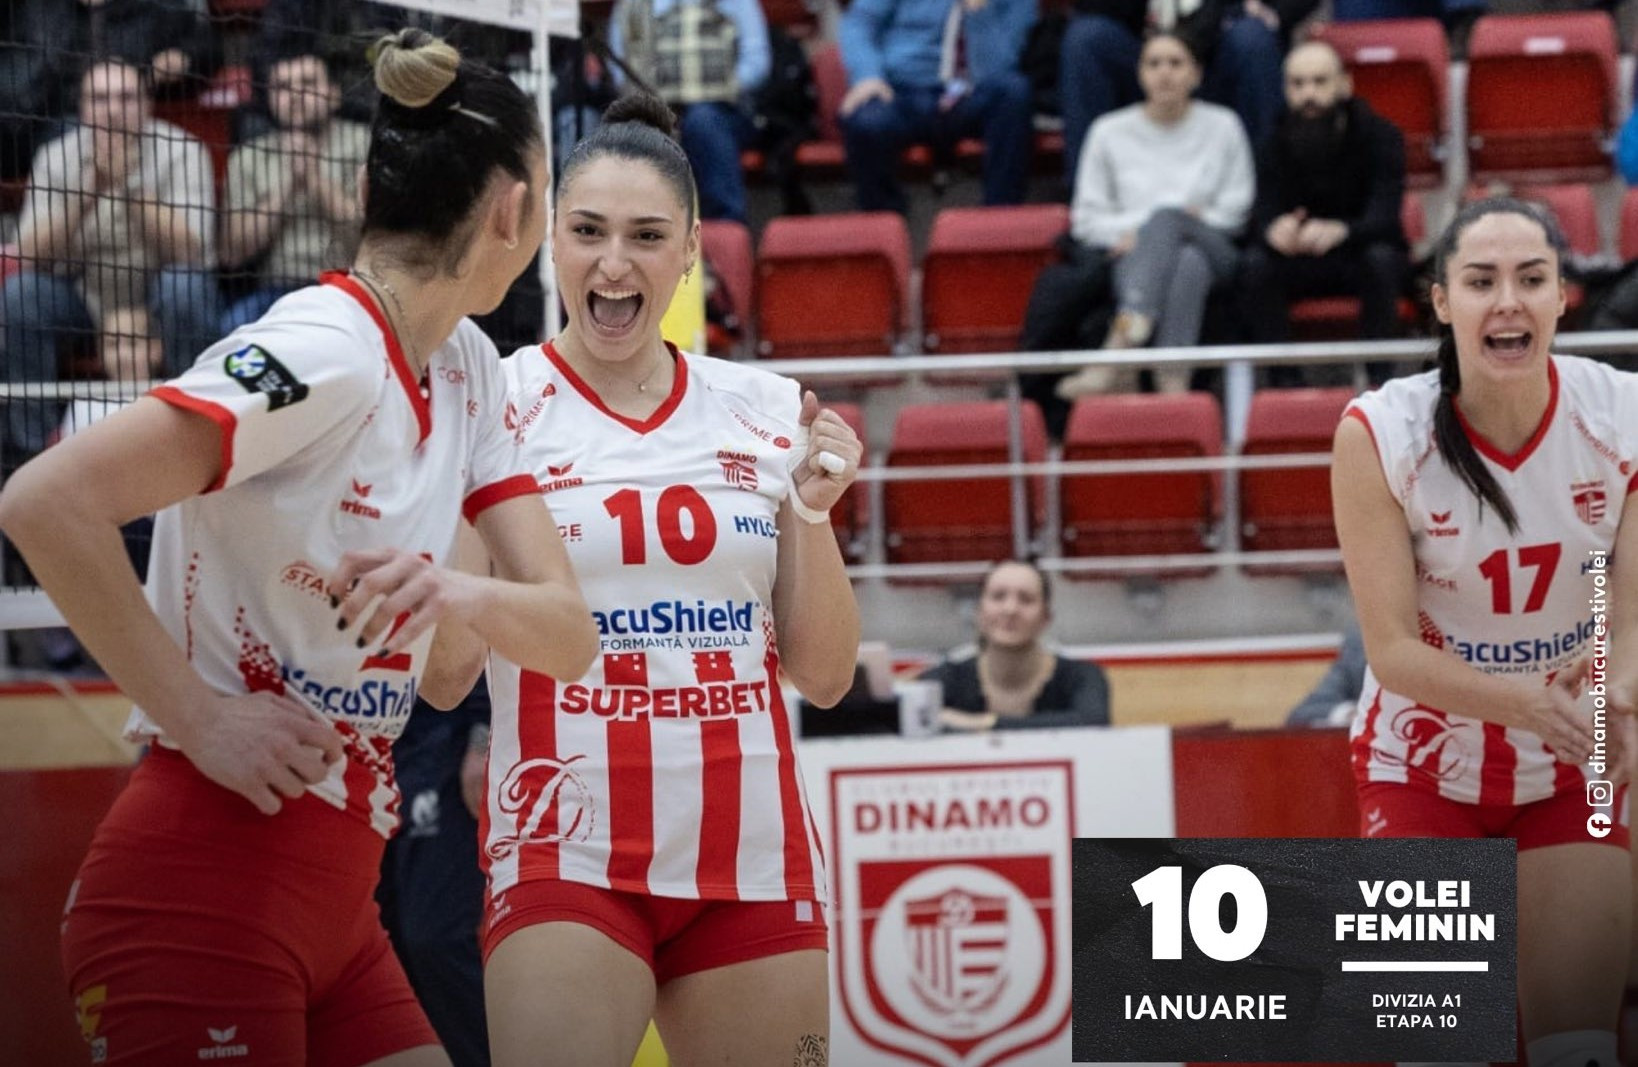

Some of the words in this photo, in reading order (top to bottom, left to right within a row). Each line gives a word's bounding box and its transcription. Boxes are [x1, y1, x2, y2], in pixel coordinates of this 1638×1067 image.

[716, 450, 758, 464] DINAMO
[603, 484, 718, 566] 10
[1478, 542, 1562, 615] 17
[560, 680, 767, 718] SUPERBET
[853, 796, 1051, 834] DINAMO
[198, 1043, 248, 1060] erima
